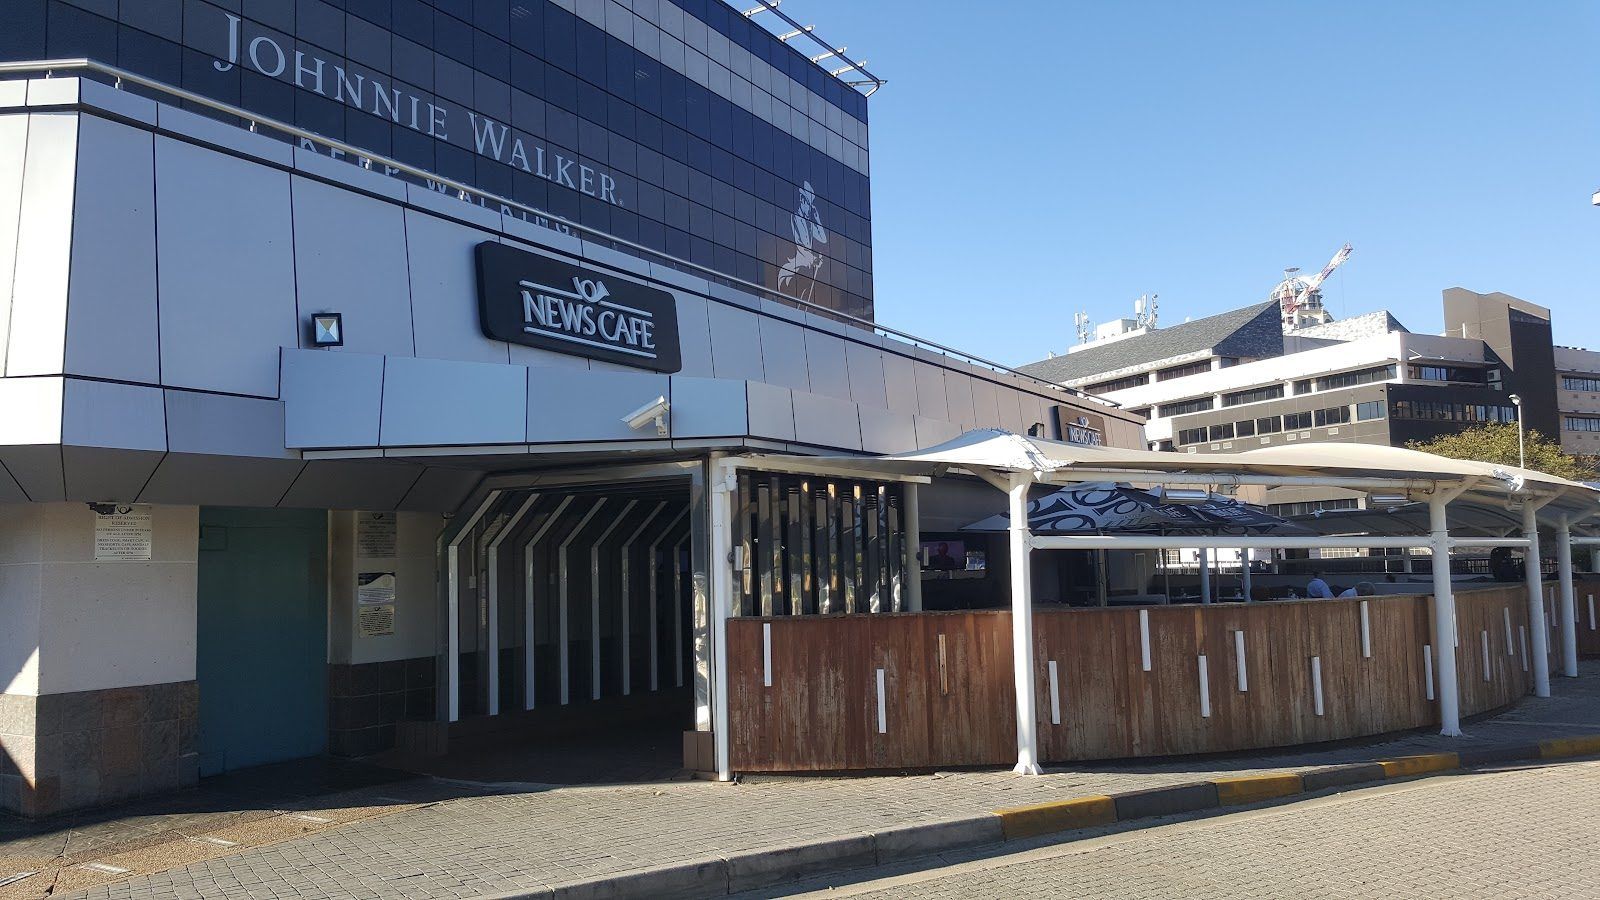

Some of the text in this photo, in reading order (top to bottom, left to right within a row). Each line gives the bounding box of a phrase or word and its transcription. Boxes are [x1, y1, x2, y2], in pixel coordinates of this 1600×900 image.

[213, 13, 449, 142] JOHNNIE
[520, 290, 656, 349] NEWS CAFE
